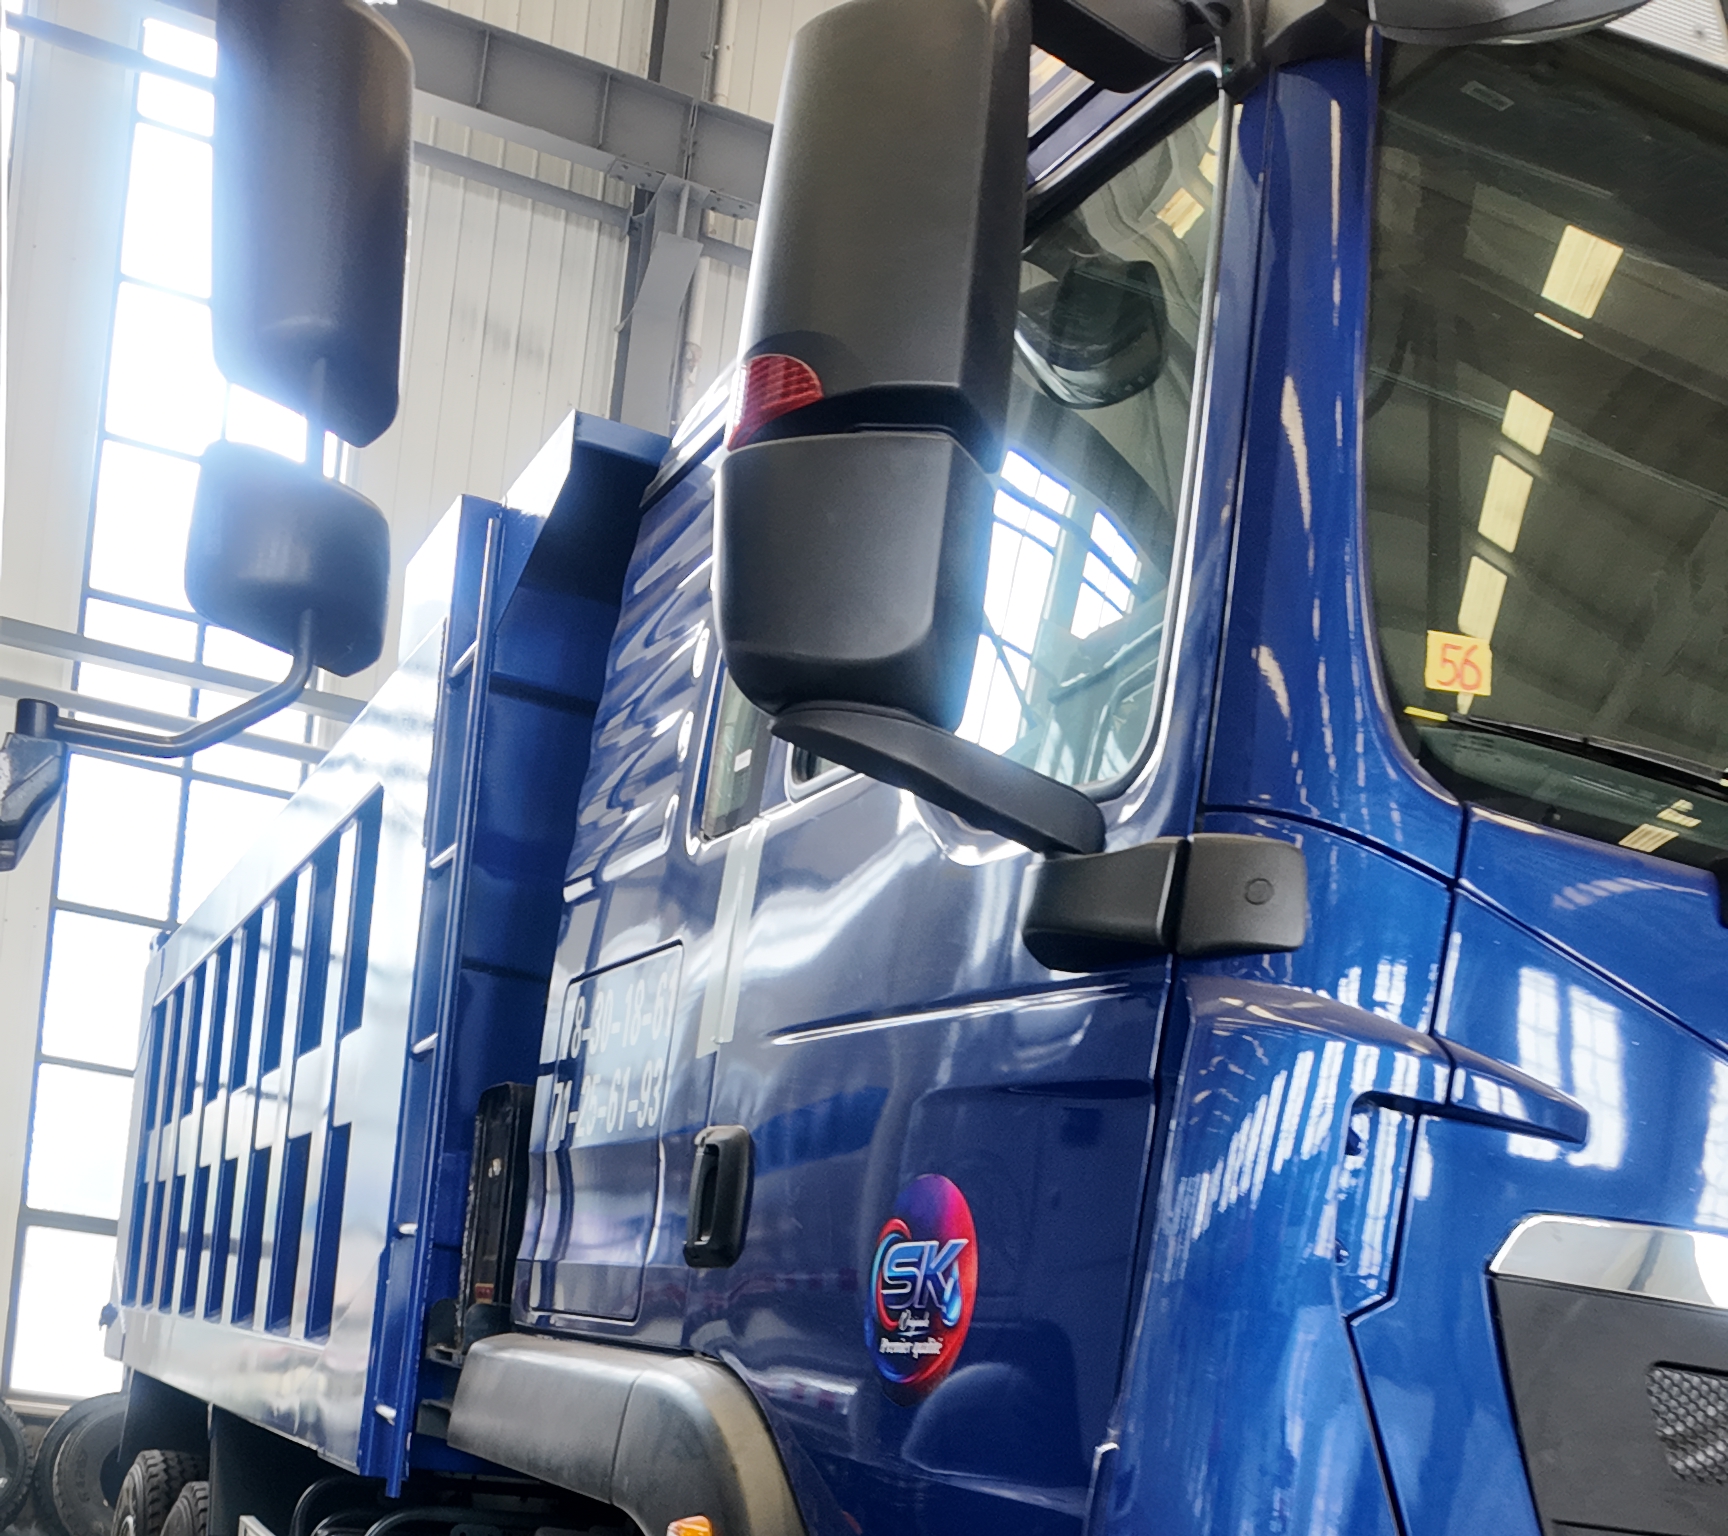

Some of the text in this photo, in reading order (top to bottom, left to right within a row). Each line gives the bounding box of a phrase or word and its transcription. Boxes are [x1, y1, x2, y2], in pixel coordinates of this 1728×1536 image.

[1437, 643, 1483, 691] 56
[560, 968, 679, 1060] 78-30-18-61
[548, 1057, 664, 1143] 71-25-61-93
[880, 1238, 969, 1309] SK
